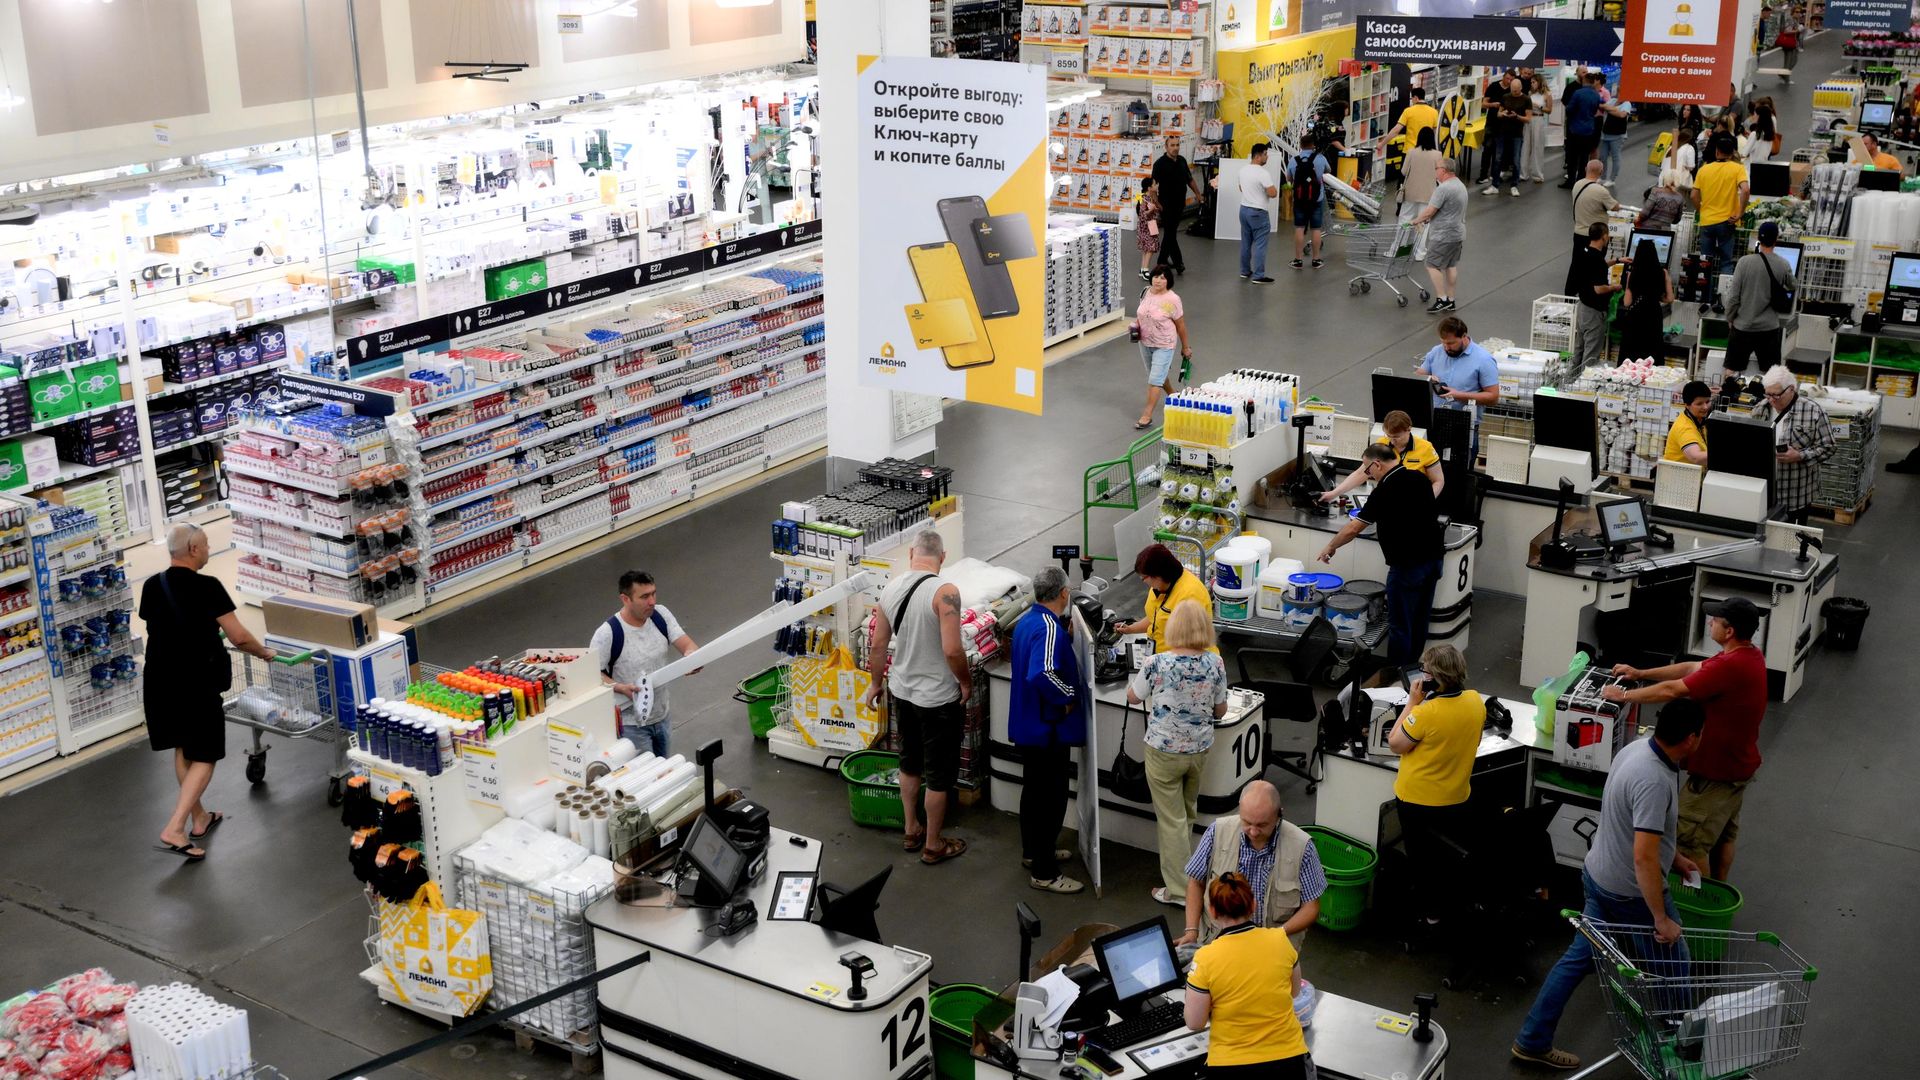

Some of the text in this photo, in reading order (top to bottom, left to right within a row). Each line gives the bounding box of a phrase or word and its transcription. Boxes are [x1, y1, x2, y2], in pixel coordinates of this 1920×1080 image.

[1830, 0, 1858, 9] ремонт
[1868, 2, 1907, 10] установка
[1851, 8, 1891, 18] гарантией
[1366, 20, 1406, 34] Касса
[1842, 20, 1890, 28] lemanapro.ru
[1364, 36, 1506, 52] самообслуживания
[1389, 51, 1431, 60] банковскими
[1433, 52, 1462, 61] картами
[1641, 52, 1716, 64] Строим бизнес
[1057, 60, 1078, 68] 8590
[1250, 50, 1324, 84] Выигрывайте
[1642, 66, 1676, 74] вместе
[1688, 67, 1712, 76] вами
[874, 80, 1023, 108] Откройте выгоду:
[1165, 94, 1183, 103] 200
[1644, 90, 1705, 101] lemanapro.ru
[874, 104, 1004, 125] выберите свою
[874, 124, 978, 149] Ключ-карту
[874, 150, 1005, 171] и копите баллы
[795, 227, 804, 235] E27
[726, 244, 737, 253] E27
[726, 250, 745, 260] большой
[650, 264, 662, 272] E27
[650, 267, 689, 280] большой цоколь
[568, 284, 580, 294] E27
[568, 287, 610, 302] большой цоколь
[478, 308, 492, 318] E27
[478, 310, 525, 327] большой цоколь
[379, 332, 394, 344] E27
[380, 335, 431, 352] большой цоколь
[869, 358, 907, 368] ЛЕМАНА
[281, 378, 365, 401] Светодиодные лампы E27
[368, 453, 378, 462] 451
[73, 550, 86, 560] 160
[1458, 554, 1468, 592] 8
[820, 718, 855, 729] ЛЕМАНА
[1232, 724, 1260, 778] 10
[567, 755, 581, 763] 6.50
[564, 768, 581, 778] 94.00
[483, 776, 497, 785] 6.50
[379, 785, 389, 795] 46
[481, 791, 499, 800] 94.00
[409, 972, 448, 988] ЛЕМАНА
[881, 997, 926, 1072] 12
